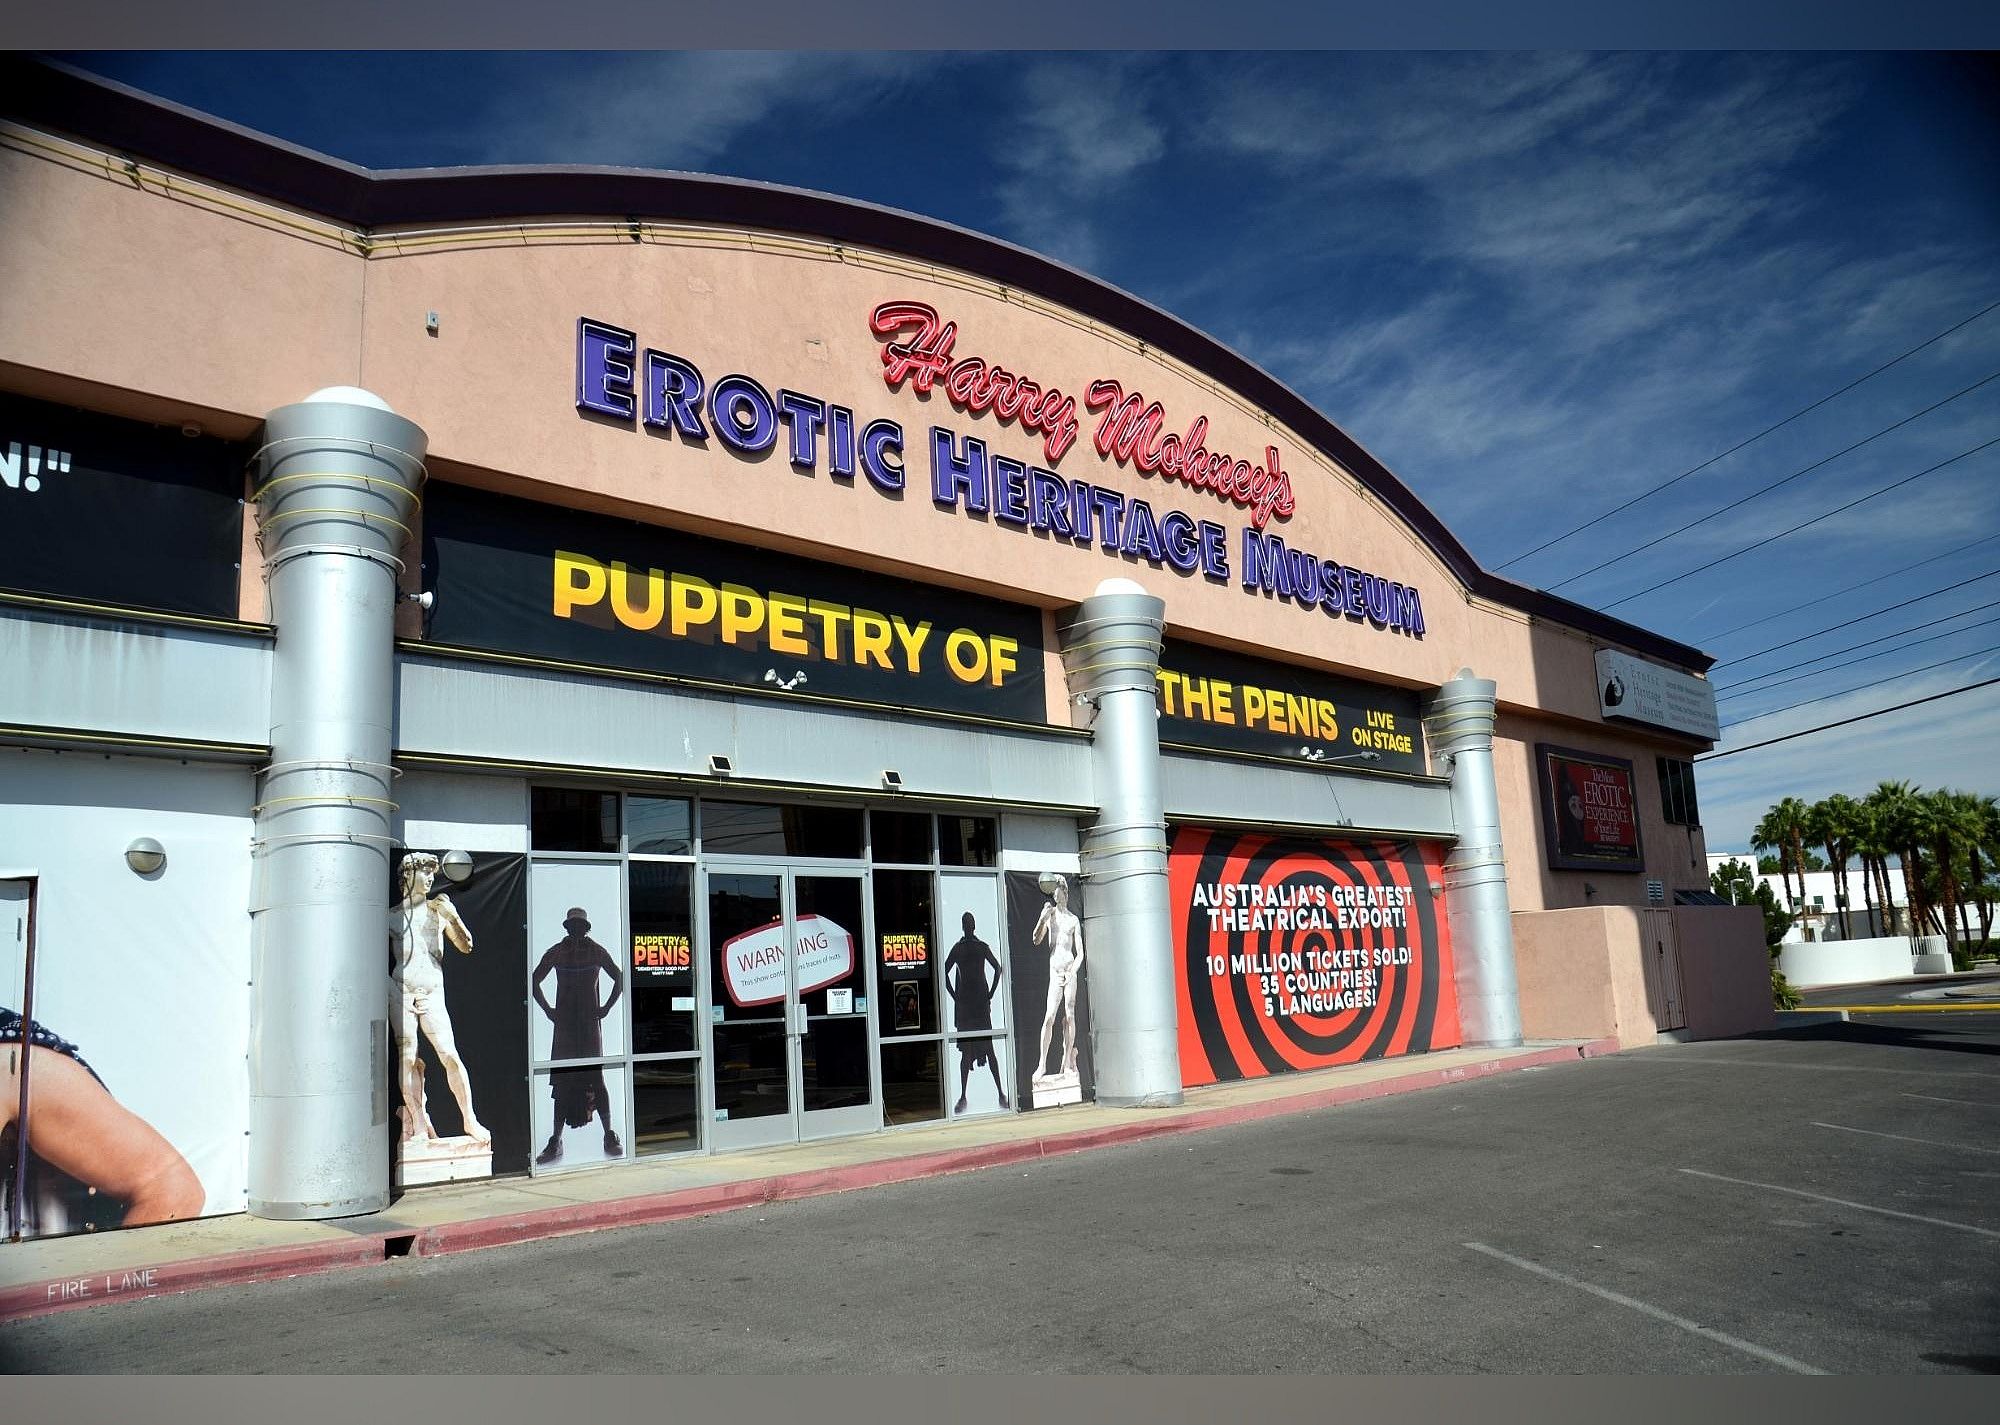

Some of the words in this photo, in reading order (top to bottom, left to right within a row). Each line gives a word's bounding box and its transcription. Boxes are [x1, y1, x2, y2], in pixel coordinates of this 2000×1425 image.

[869, 300, 1079, 461] Harry
[1084, 378, 1295, 529] Mohney's
[576, 316, 905, 491] EROTIC
[929, 425, 1230, 579] HERITAGE
[1242, 527, 1426, 635] MUSEUM
[553, 549, 933, 672] PUPPETRY
[945, 627, 1019, 687] OF
[1156, 668, 1235, 726] THE
[1243, 685, 1339, 741] PENIS
[1366, 709, 1395, 731] LIVE
[1352, 727, 1373, 746] ON
[1374, 731, 1413, 754] STAGE
[1584, 781, 1628, 808] EROTIC
[1585, 805, 1629, 823] EXPERIENCE
[1193, 883, 1325, 907] AUSTRALIA'S
[1331, 885, 1413, 906] GREATEST
[1207, 908, 1332, 932] THEATRICAL
[1338, 907, 1407, 929] EXPORT!
[635, 935, 680, 946] PUPPETRY
[883, 935, 917, 944] PUPPETRY
[884, 943, 926, 961] PENIS
[634, 945, 690, 966] PENIS
[1206, 955, 1225, 976] 10
[1232, 951, 1301, 975] MILLION
[1306, 949, 1368, 971] TICKETS
[1373, 946, 1413, 966] SOLD!
[1261, 974, 1279, 995] 35
[1285, 969, 1378, 994] COUNTRIES!
[1264, 997, 1274, 1017] 5
[1279, 988, 1377, 1016] LANGUAGES!
[47, 1278, 93, 1302] FIRE
[106, 1269, 159, 1294] LANE
